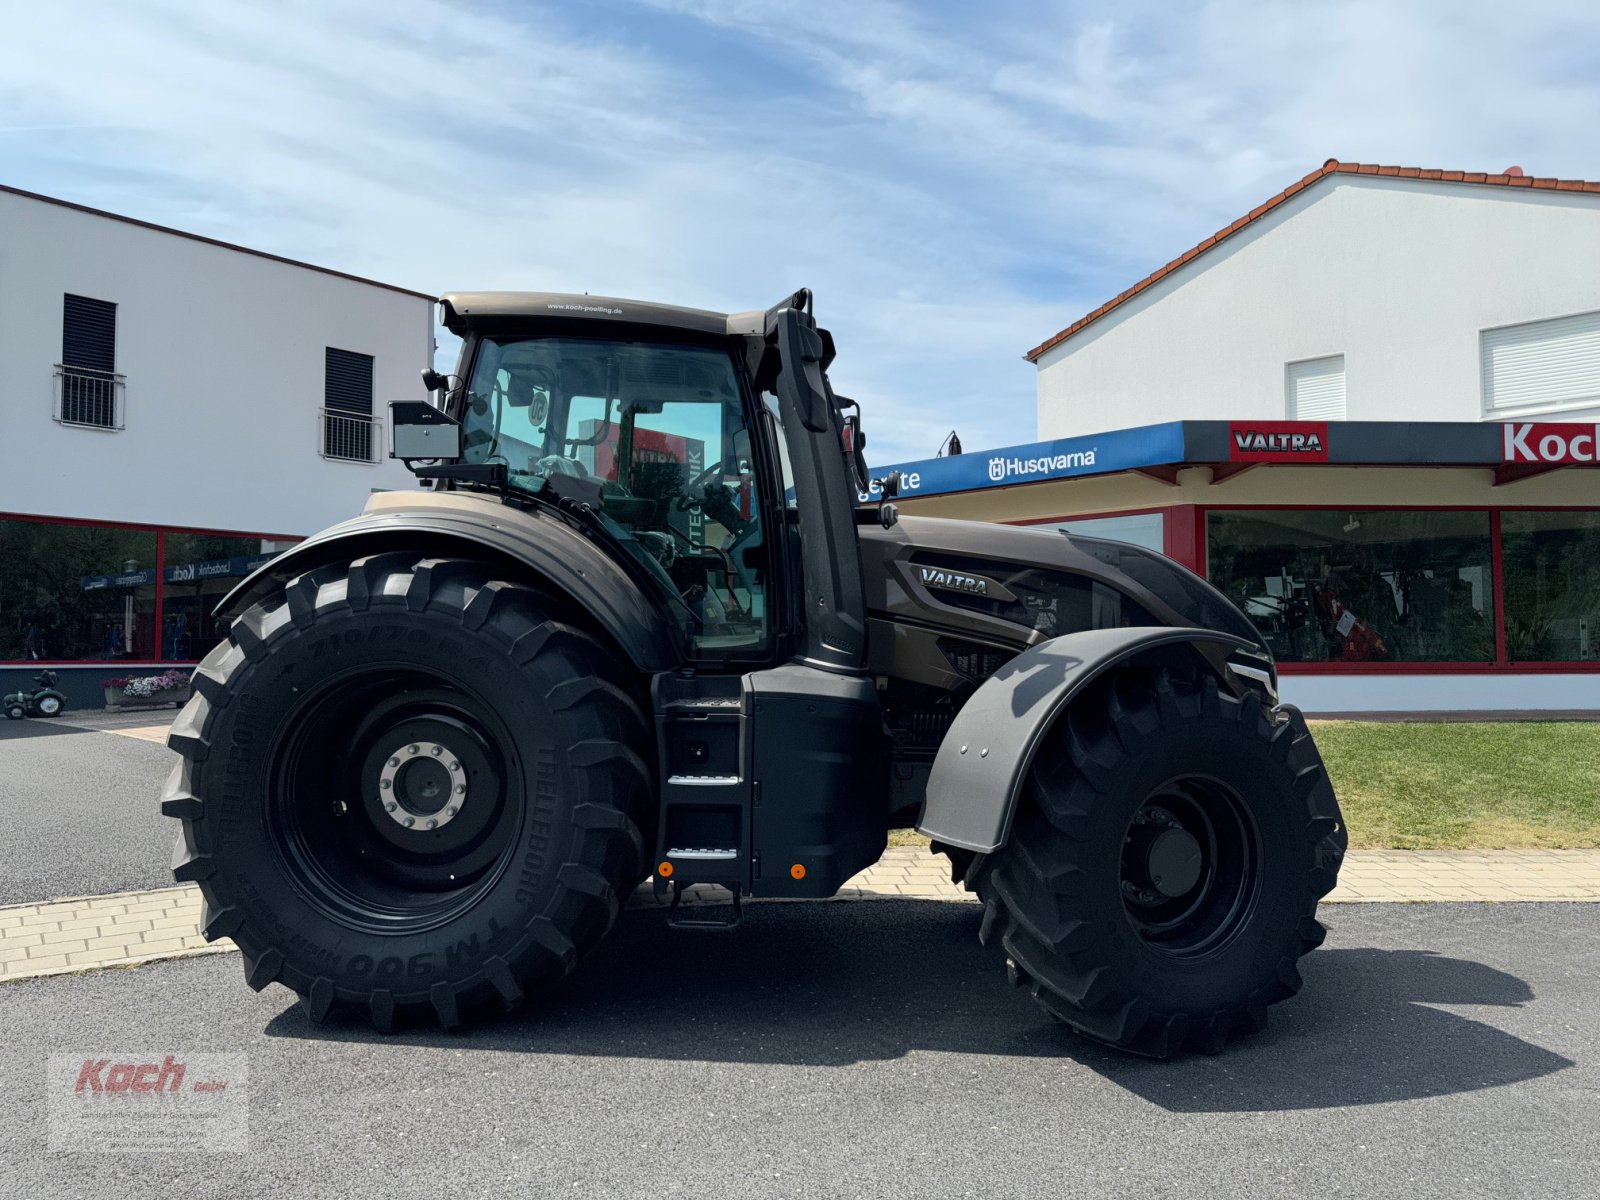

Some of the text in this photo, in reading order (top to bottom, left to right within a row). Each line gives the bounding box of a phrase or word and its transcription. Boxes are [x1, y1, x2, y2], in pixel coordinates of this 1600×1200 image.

[547, 303, 623, 315] www.koch-poelling.de
[1233, 431, 1322, 452] VALTRA
[1503, 424, 1600, 461] Koc
[1006, 450, 1095, 474] Husqvarna
[921, 568, 987, 594] VALTRA
[515, 744, 559, 906] TRELLEBORG
[345, 953, 433, 979] 900
